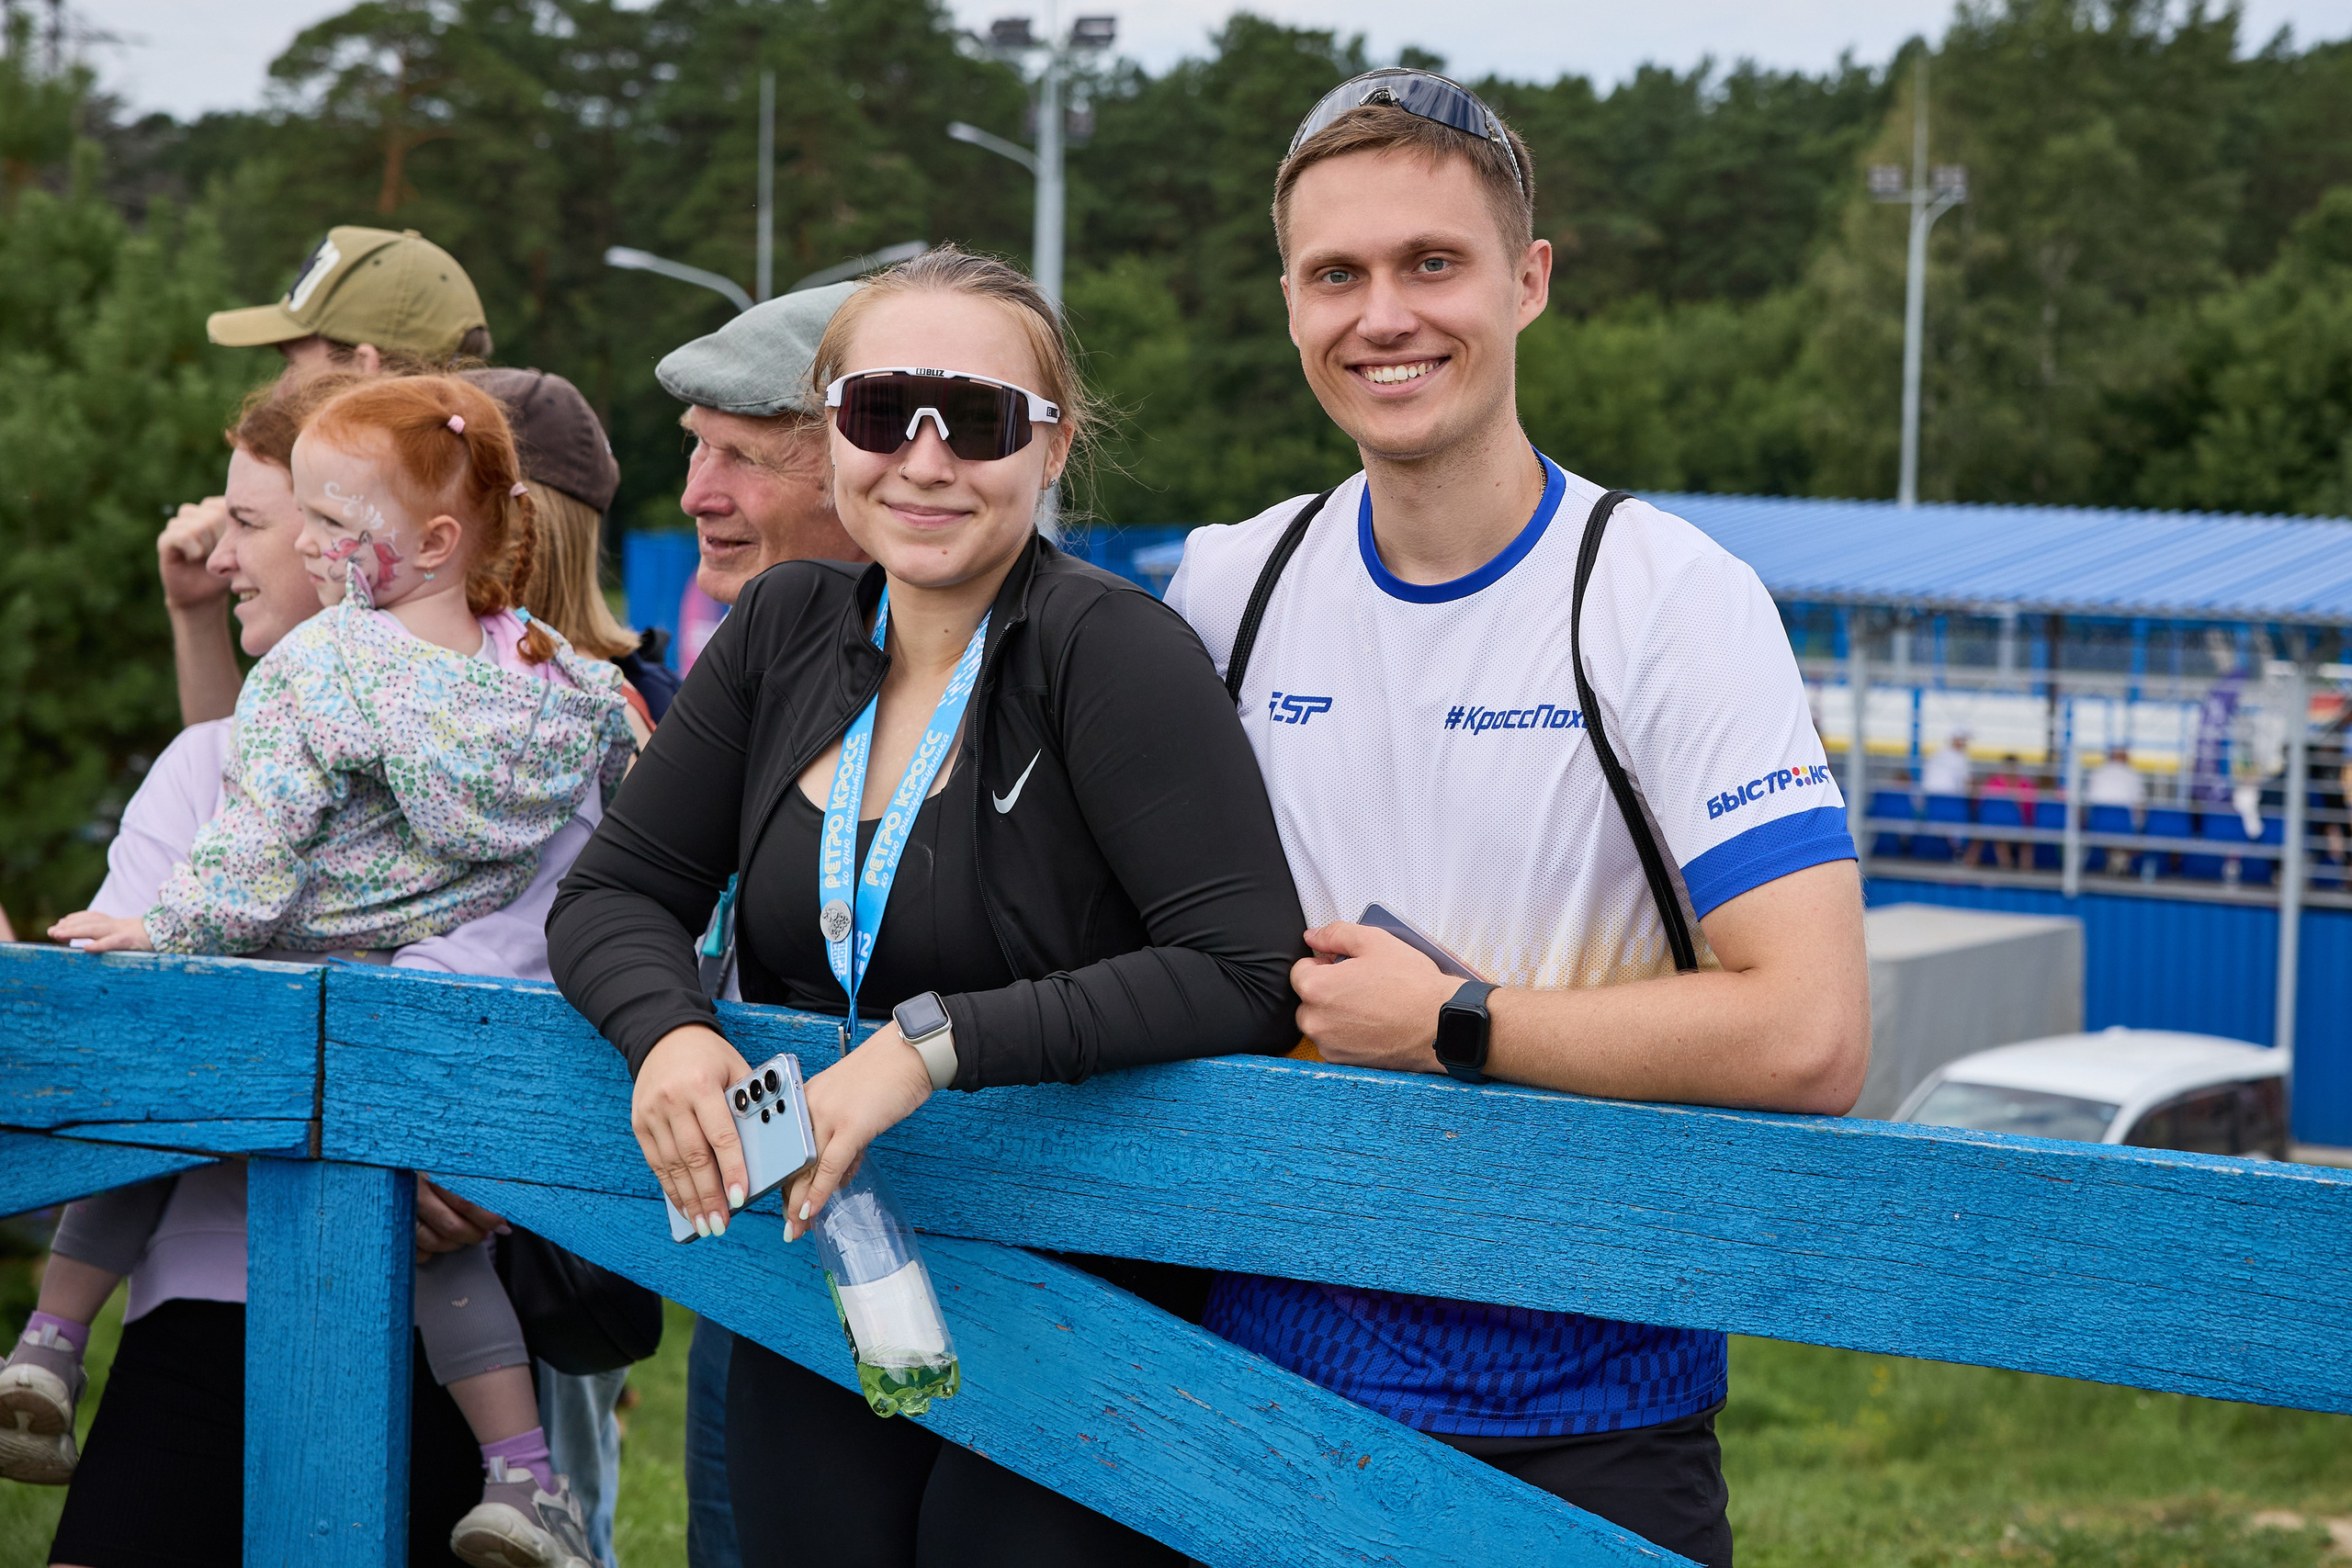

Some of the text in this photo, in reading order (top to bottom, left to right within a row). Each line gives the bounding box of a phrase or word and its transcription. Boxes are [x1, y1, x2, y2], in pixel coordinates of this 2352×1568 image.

[926, 368, 944, 378] BLIZ
[1443, 705, 1588, 736] #КроссПох
[824, 734, 861, 888] РЕТРО КРОСС
[865, 729, 943, 886] РЕТРО КРОСС
[842, 870, 850, 886] ко
[880, 872, 889, 888] ко
[856, 930, 872, 958] 12
